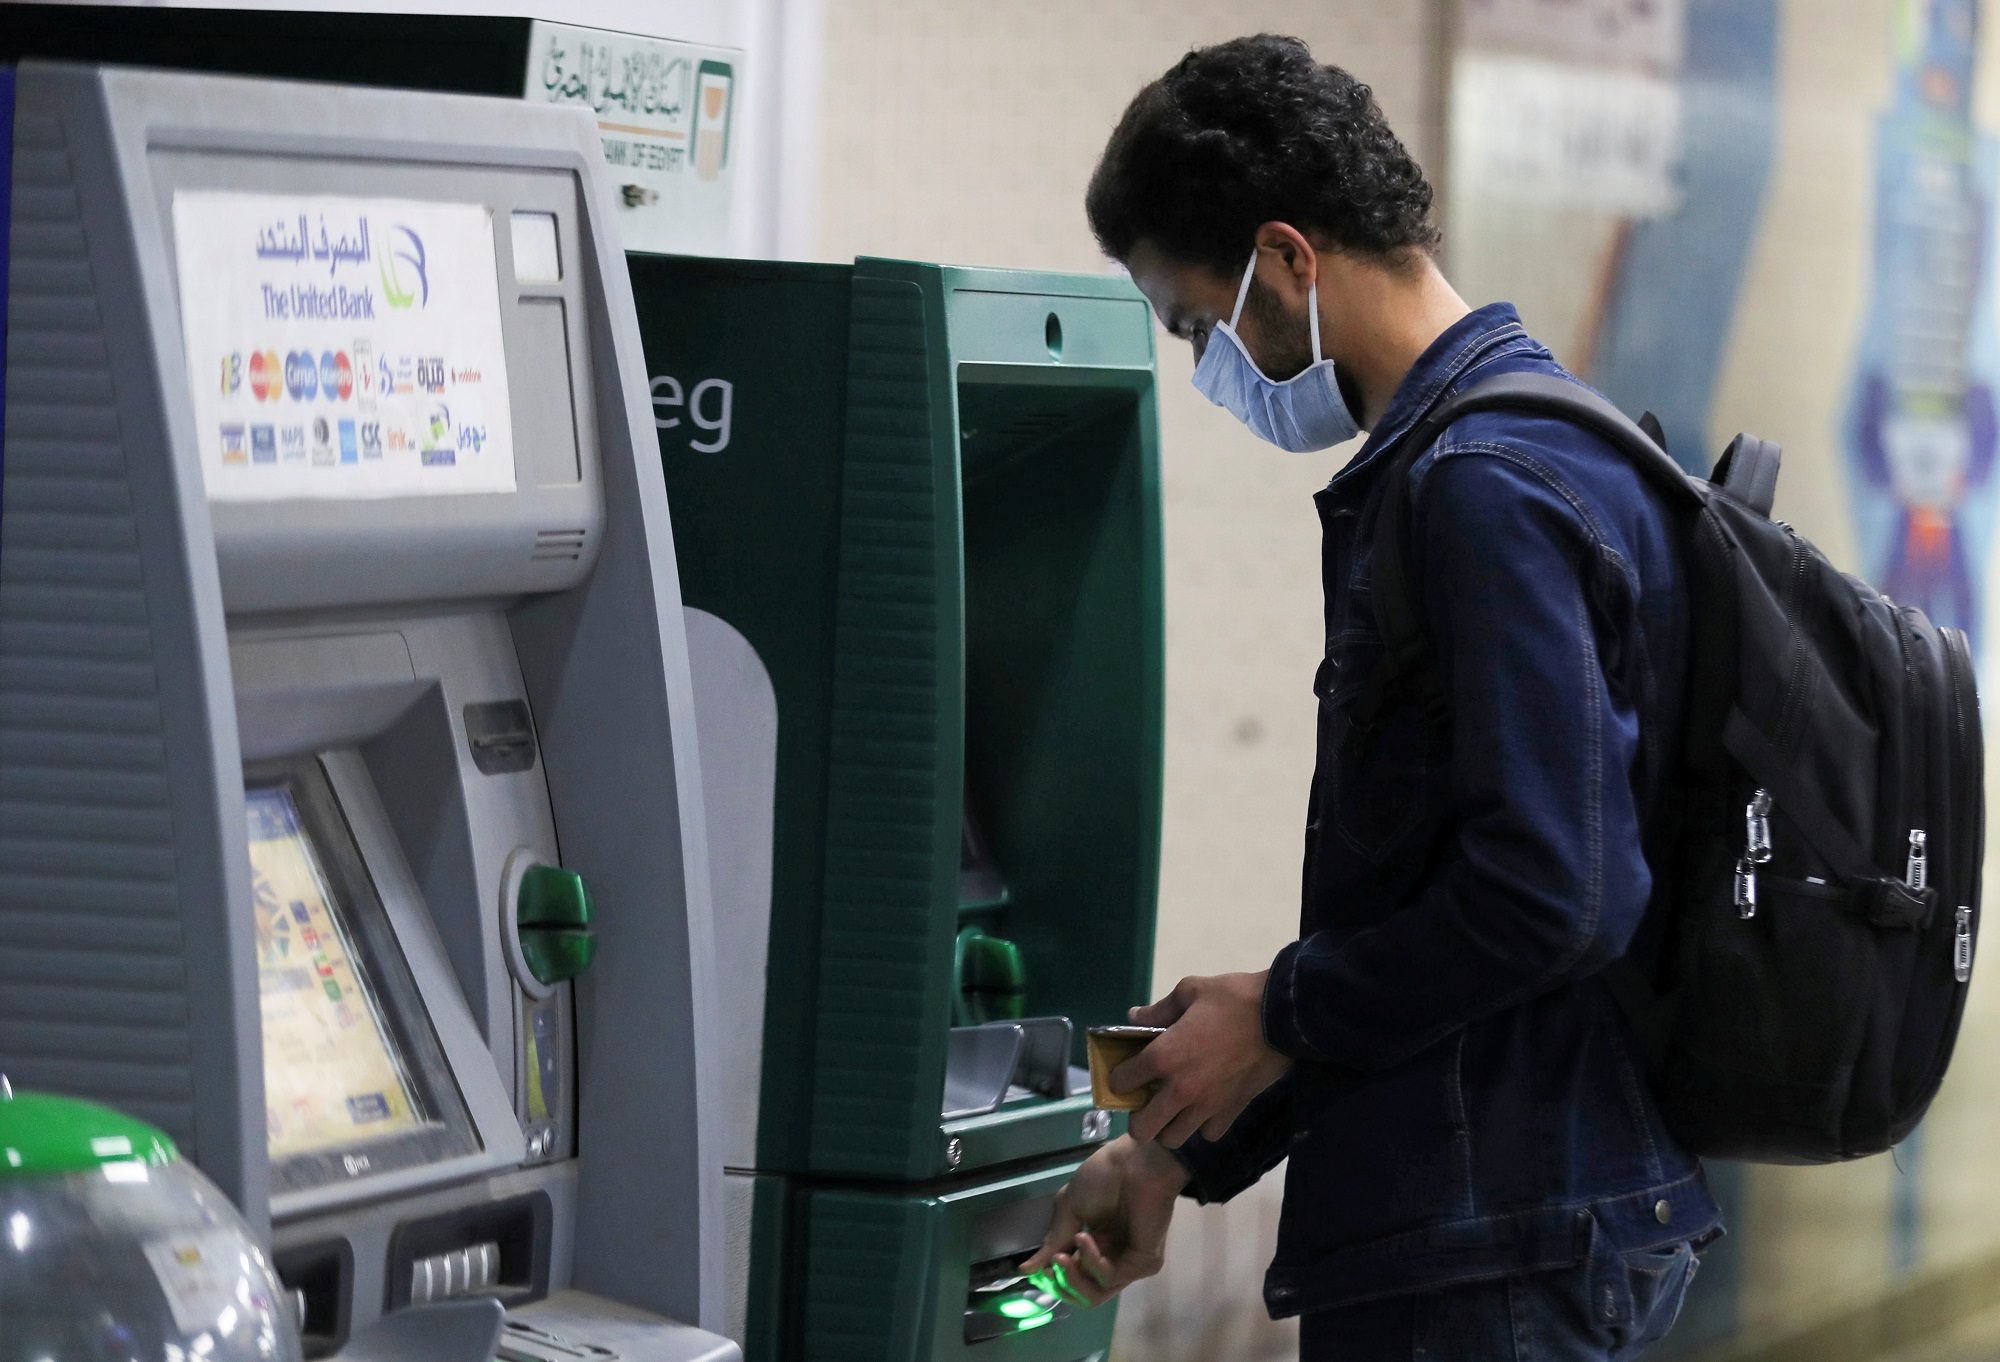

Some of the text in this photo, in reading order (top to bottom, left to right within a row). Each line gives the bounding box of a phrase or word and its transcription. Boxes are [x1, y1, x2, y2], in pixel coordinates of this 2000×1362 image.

[601, 137, 684, 174] ANK OF EGYPT
[256, 213, 370, 278] المصرف المتحد
[260, 281, 375, 320] The United Bank
